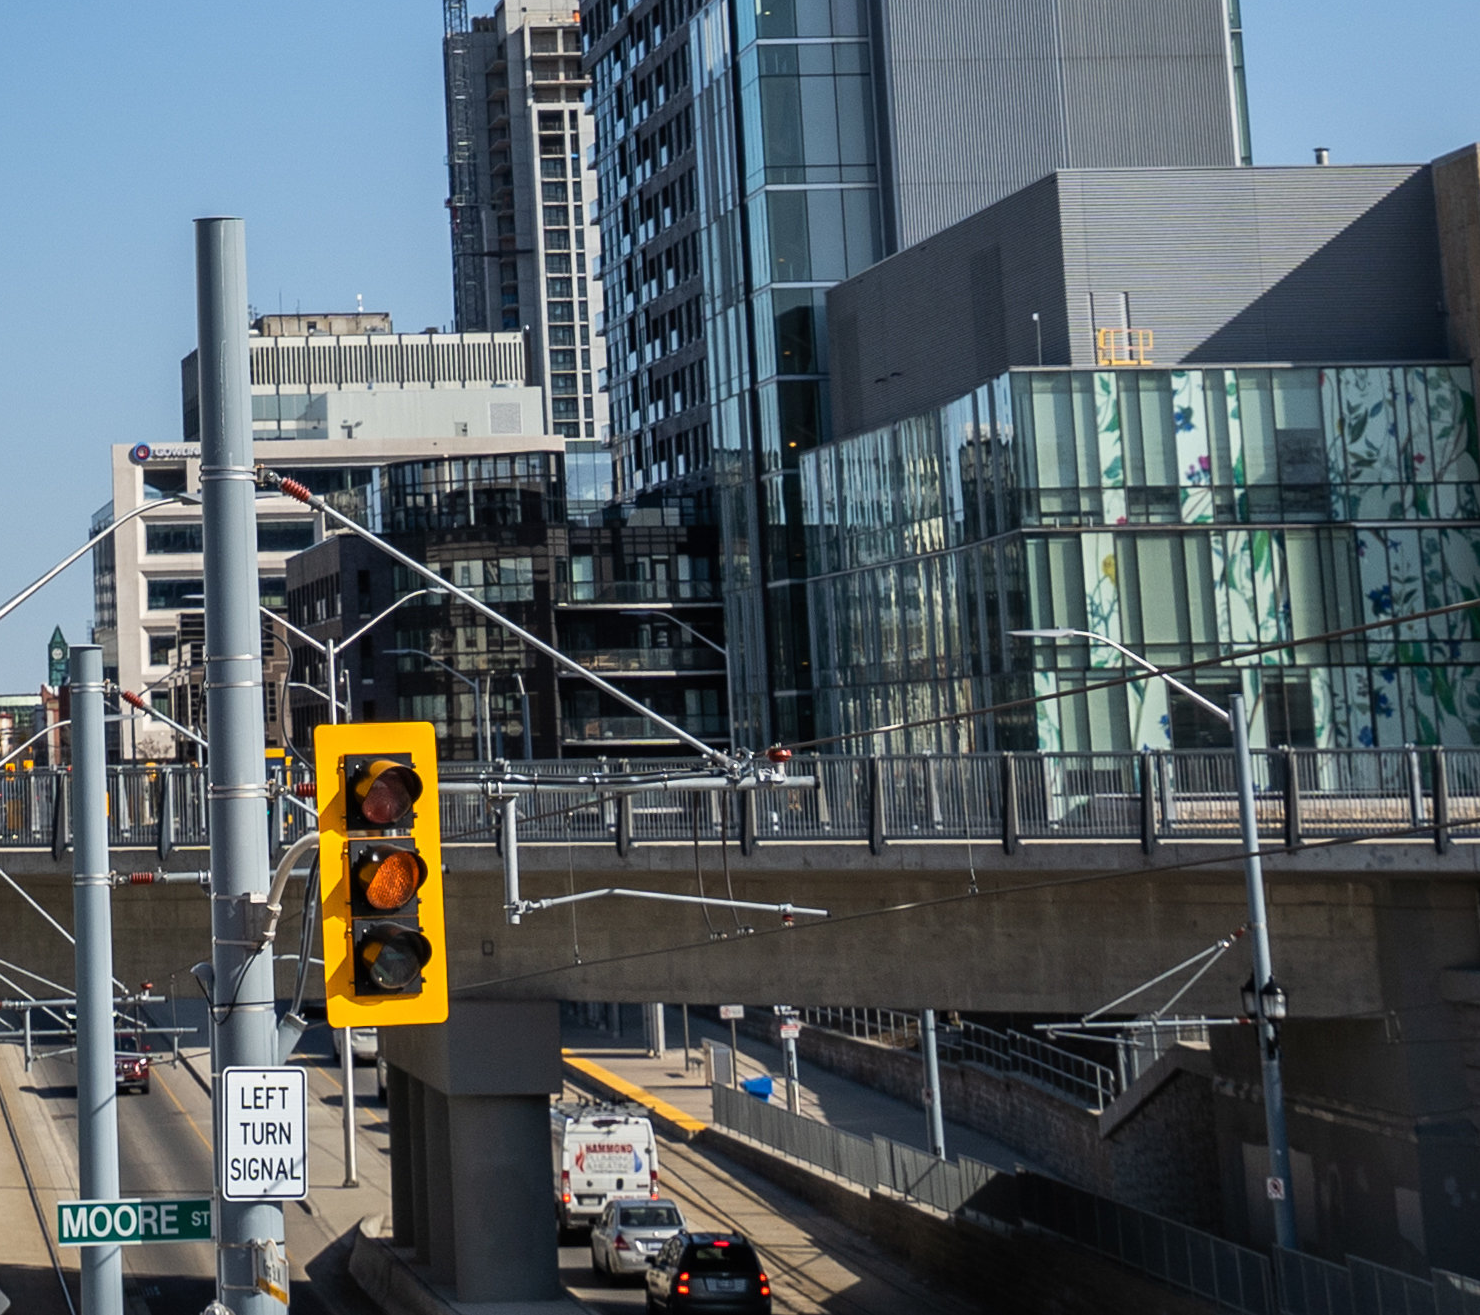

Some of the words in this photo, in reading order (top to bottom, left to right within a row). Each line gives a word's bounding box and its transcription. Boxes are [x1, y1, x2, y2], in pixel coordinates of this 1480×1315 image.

[241, 1086, 289, 1110] LEFT
[239, 1122, 291, 1145] TURN
[585, 1143, 633, 1154] HAMMOND
[230, 1157, 301, 1181] SIGNAL
[62, 1204, 179, 1238] MOORE
[191, 1210, 210, 1227] ST
